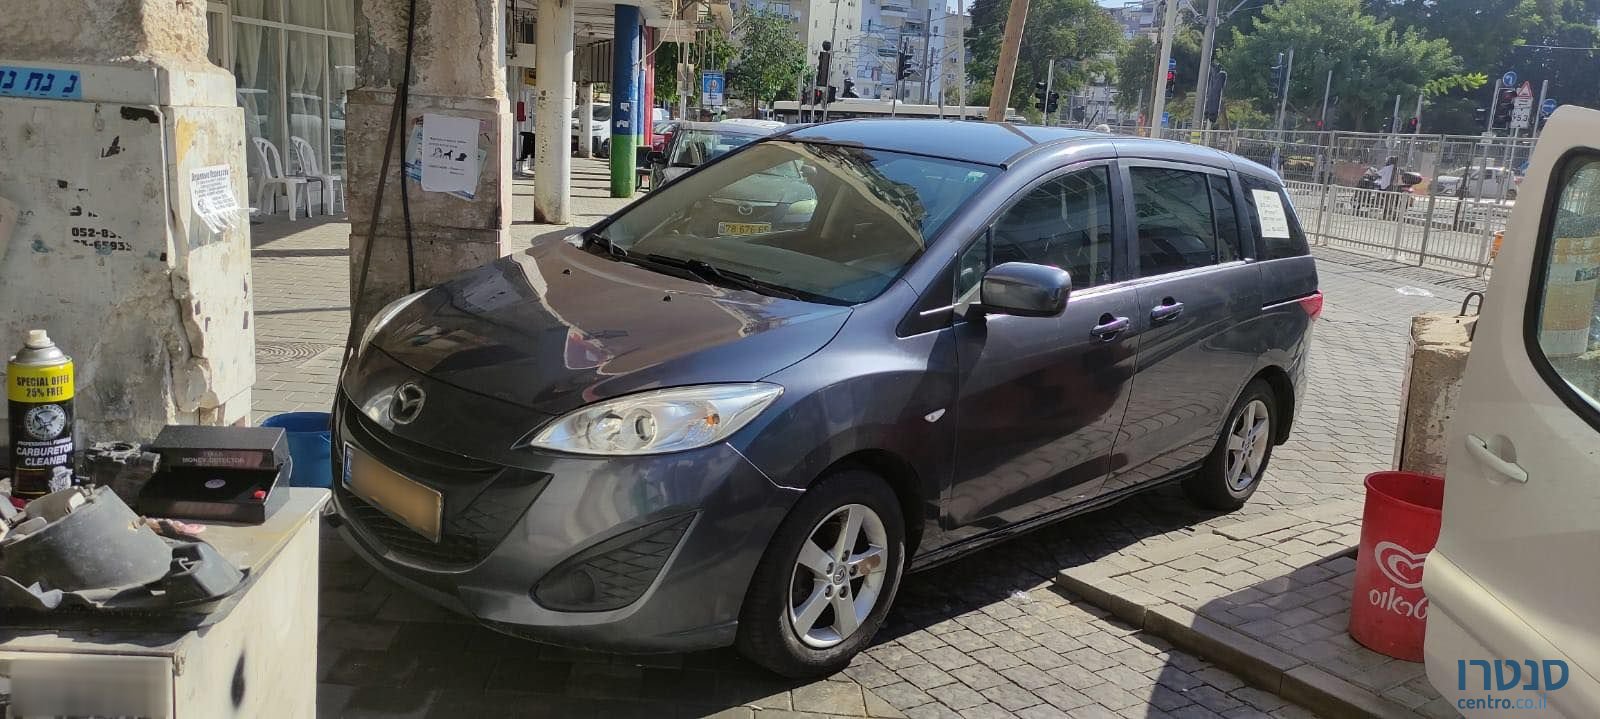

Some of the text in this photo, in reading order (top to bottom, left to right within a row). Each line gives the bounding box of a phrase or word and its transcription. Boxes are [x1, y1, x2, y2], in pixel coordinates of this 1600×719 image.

[25, 71, 55, 96] נח
[62, 74, 78, 97] נ
[16, 376, 49, 387] SPECIAL
[26, 386, 64, 398] 25% FREE
[16, 442, 73, 457] CARBURETOR
[25, 454, 67, 466] CLEANER
[1369, 587, 1428, 620] טראוס
